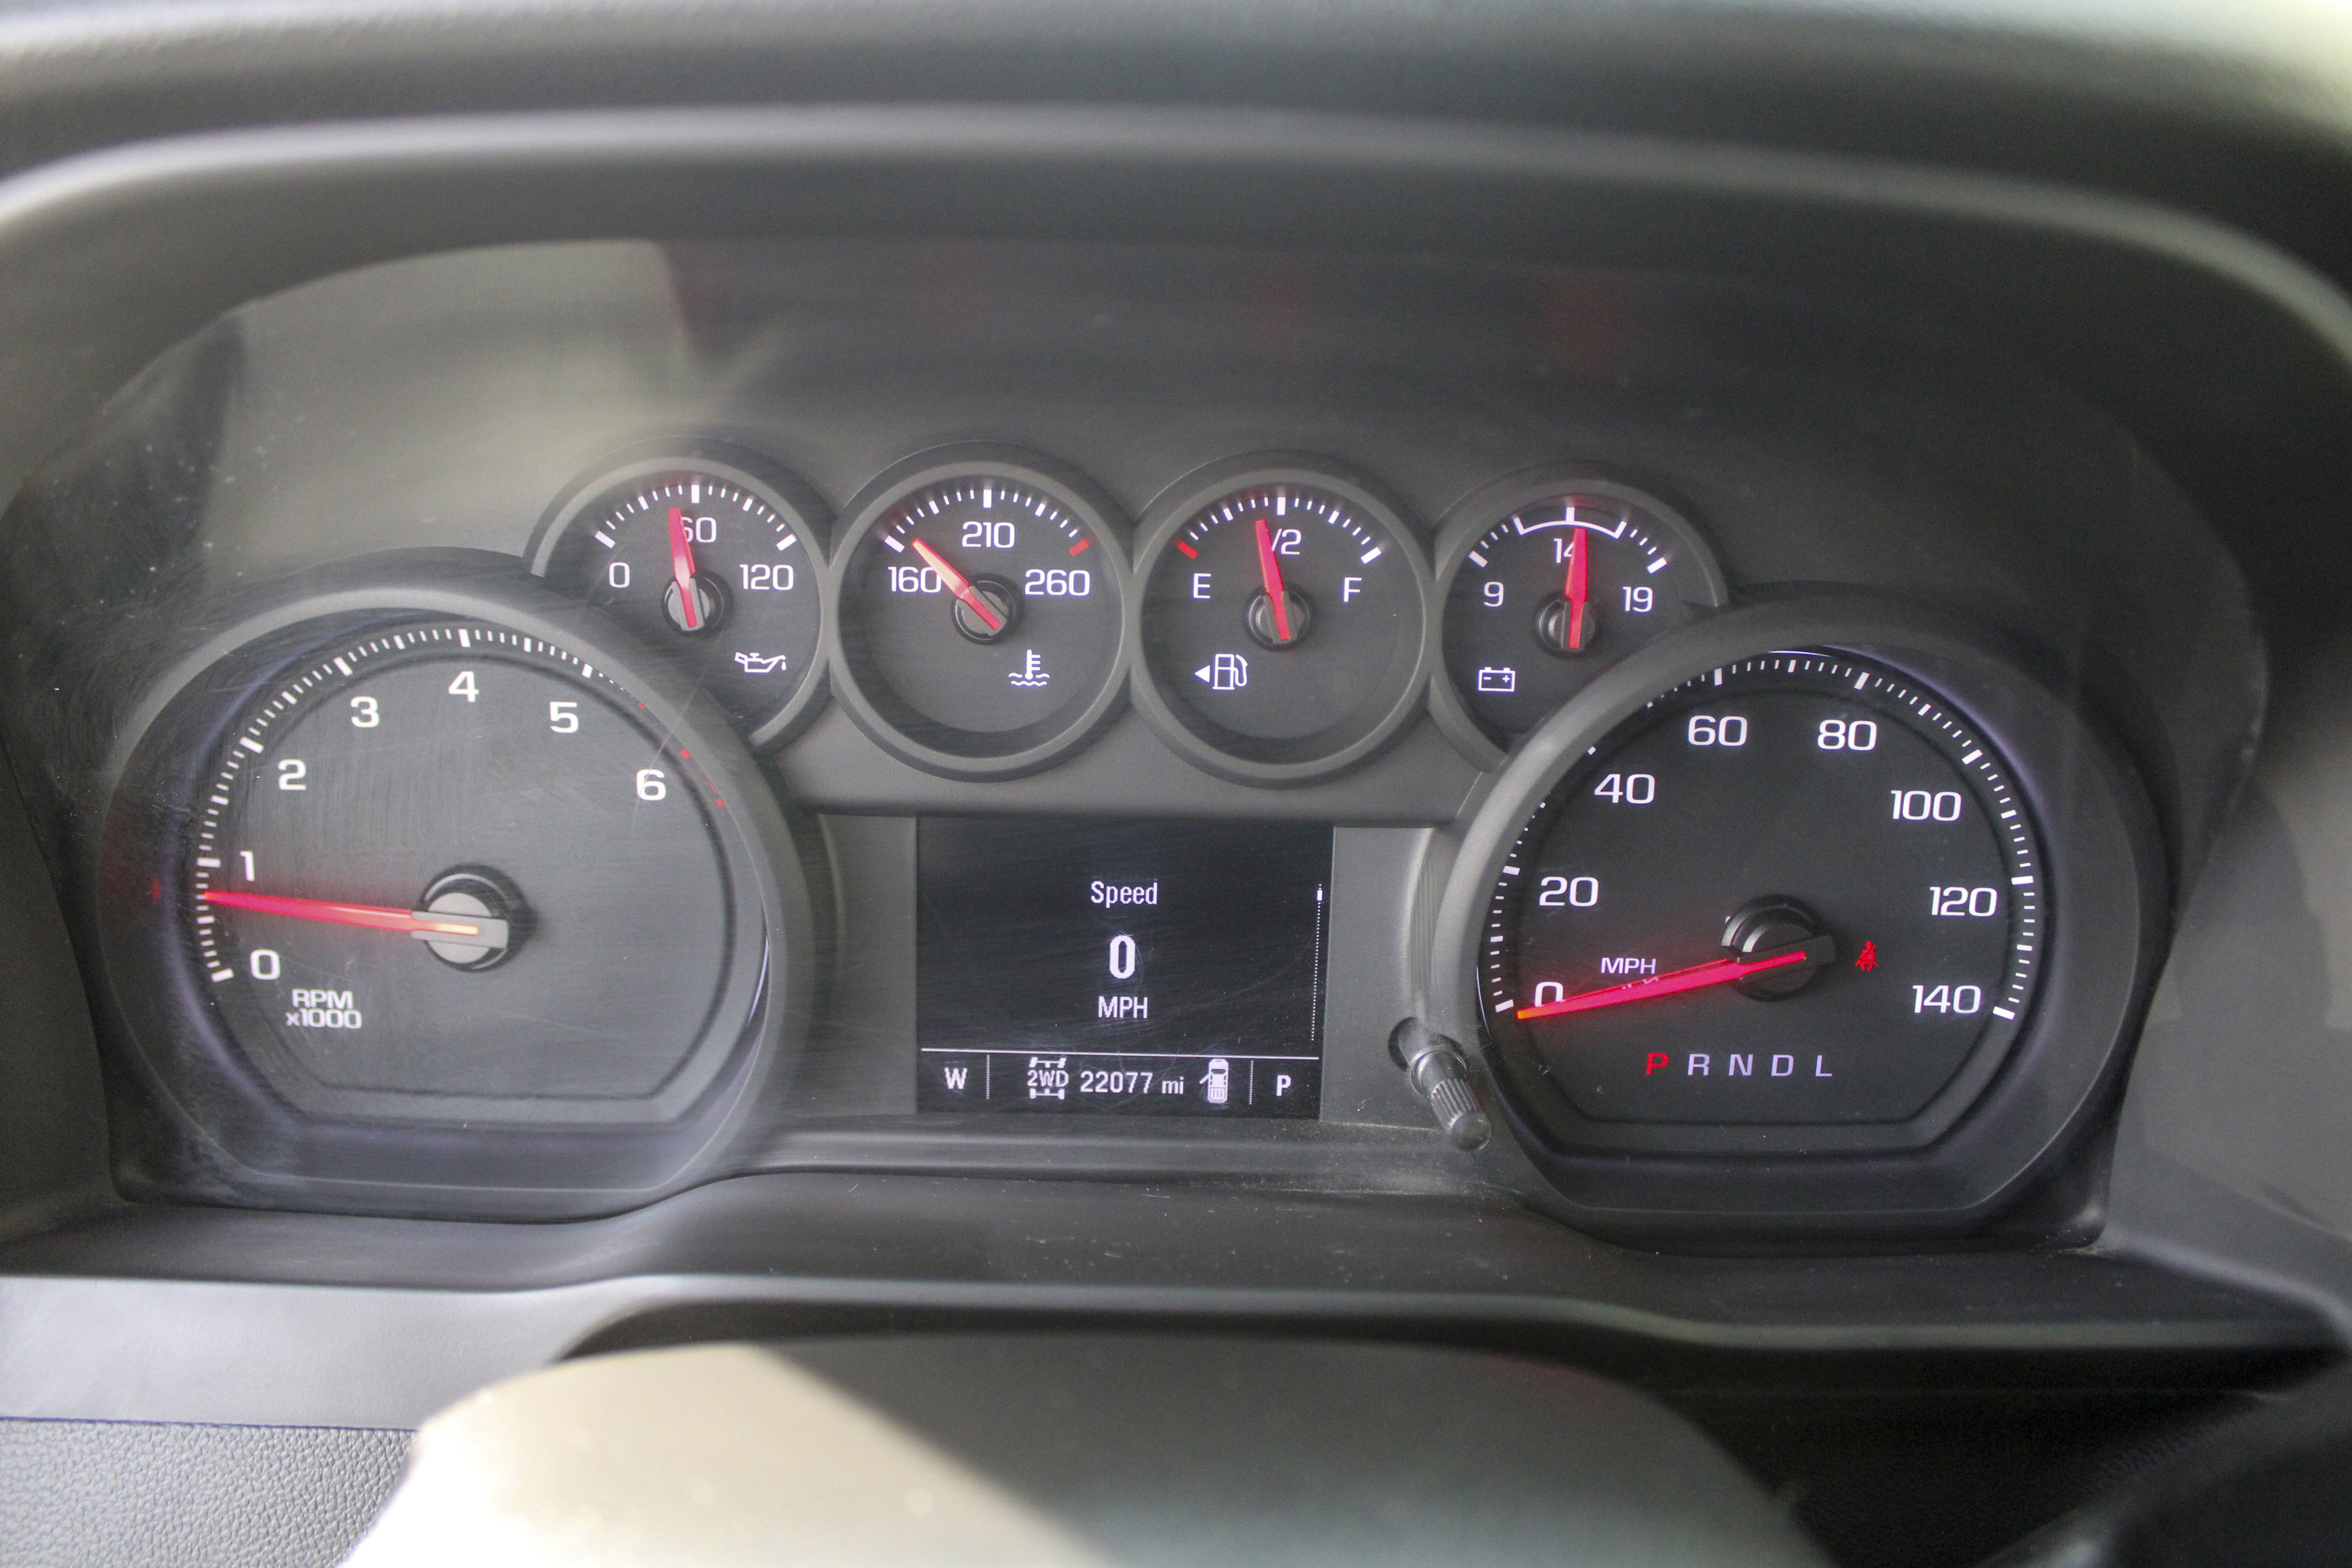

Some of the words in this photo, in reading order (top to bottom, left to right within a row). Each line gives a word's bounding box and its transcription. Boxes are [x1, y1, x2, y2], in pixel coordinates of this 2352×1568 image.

[962, 521, 1015, 548] 210
[1271, 528, 1302, 555] /2
[609, 562, 630, 588] 0
[739, 564, 794, 591] 120
[888, 566, 942, 593] 160
[1025, 568, 1090, 596] 260
[1193, 572, 1212, 599] E
[1343, 577, 1362, 603] F
[1483, 581, 1504, 607] 9
[1622, 586, 1653, 612] 19
[448, 671, 479, 703] 4
[350, 696, 379, 728] 3
[549, 701, 579, 733] 5
[1688, 715, 1748, 746] 60
[1817, 719, 1877, 751] 80
[278, 759, 307, 791] 2
[636, 768, 666, 801] 6
[1594, 773, 1655, 804] 40
[1891, 790, 1962, 822] 100
[240, 851, 255, 882] 1
[1091, 880, 1158, 909] Speed
[1539, 876, 1599, 907] 20
[1929, 886, 1998, 917] 120
[250, 950, 281, 980] 0
[1109, 934, 1136, 979] 0
[1601, 957, 1657, 974] MPH
[292, 989, 354, 1008] RPM
[1098, 996, 1148, 1019] MPH
[1534, 981, 1564, 1007] 0
[1912, 984, 1981, 1014] 140
[286, 1009, 363, 1029] x1000
[1027, 1069, 1069, 1087] 2WD
[1646, 1052, 1669, 1076] P
[1687, 1053, 1710, 1076] R
[1728, 1054, 1754, 1076] N
[1771, 1054, 1794, 1076] D
[1815, 1054, 1833, 1077] L
[944, 1067, 968, 1090] W
[1080, 1070, 1153, 1094] 22077
[1161, 1076, 1184, 1095] mi
[1276, 1074, 1292, 1097] P
